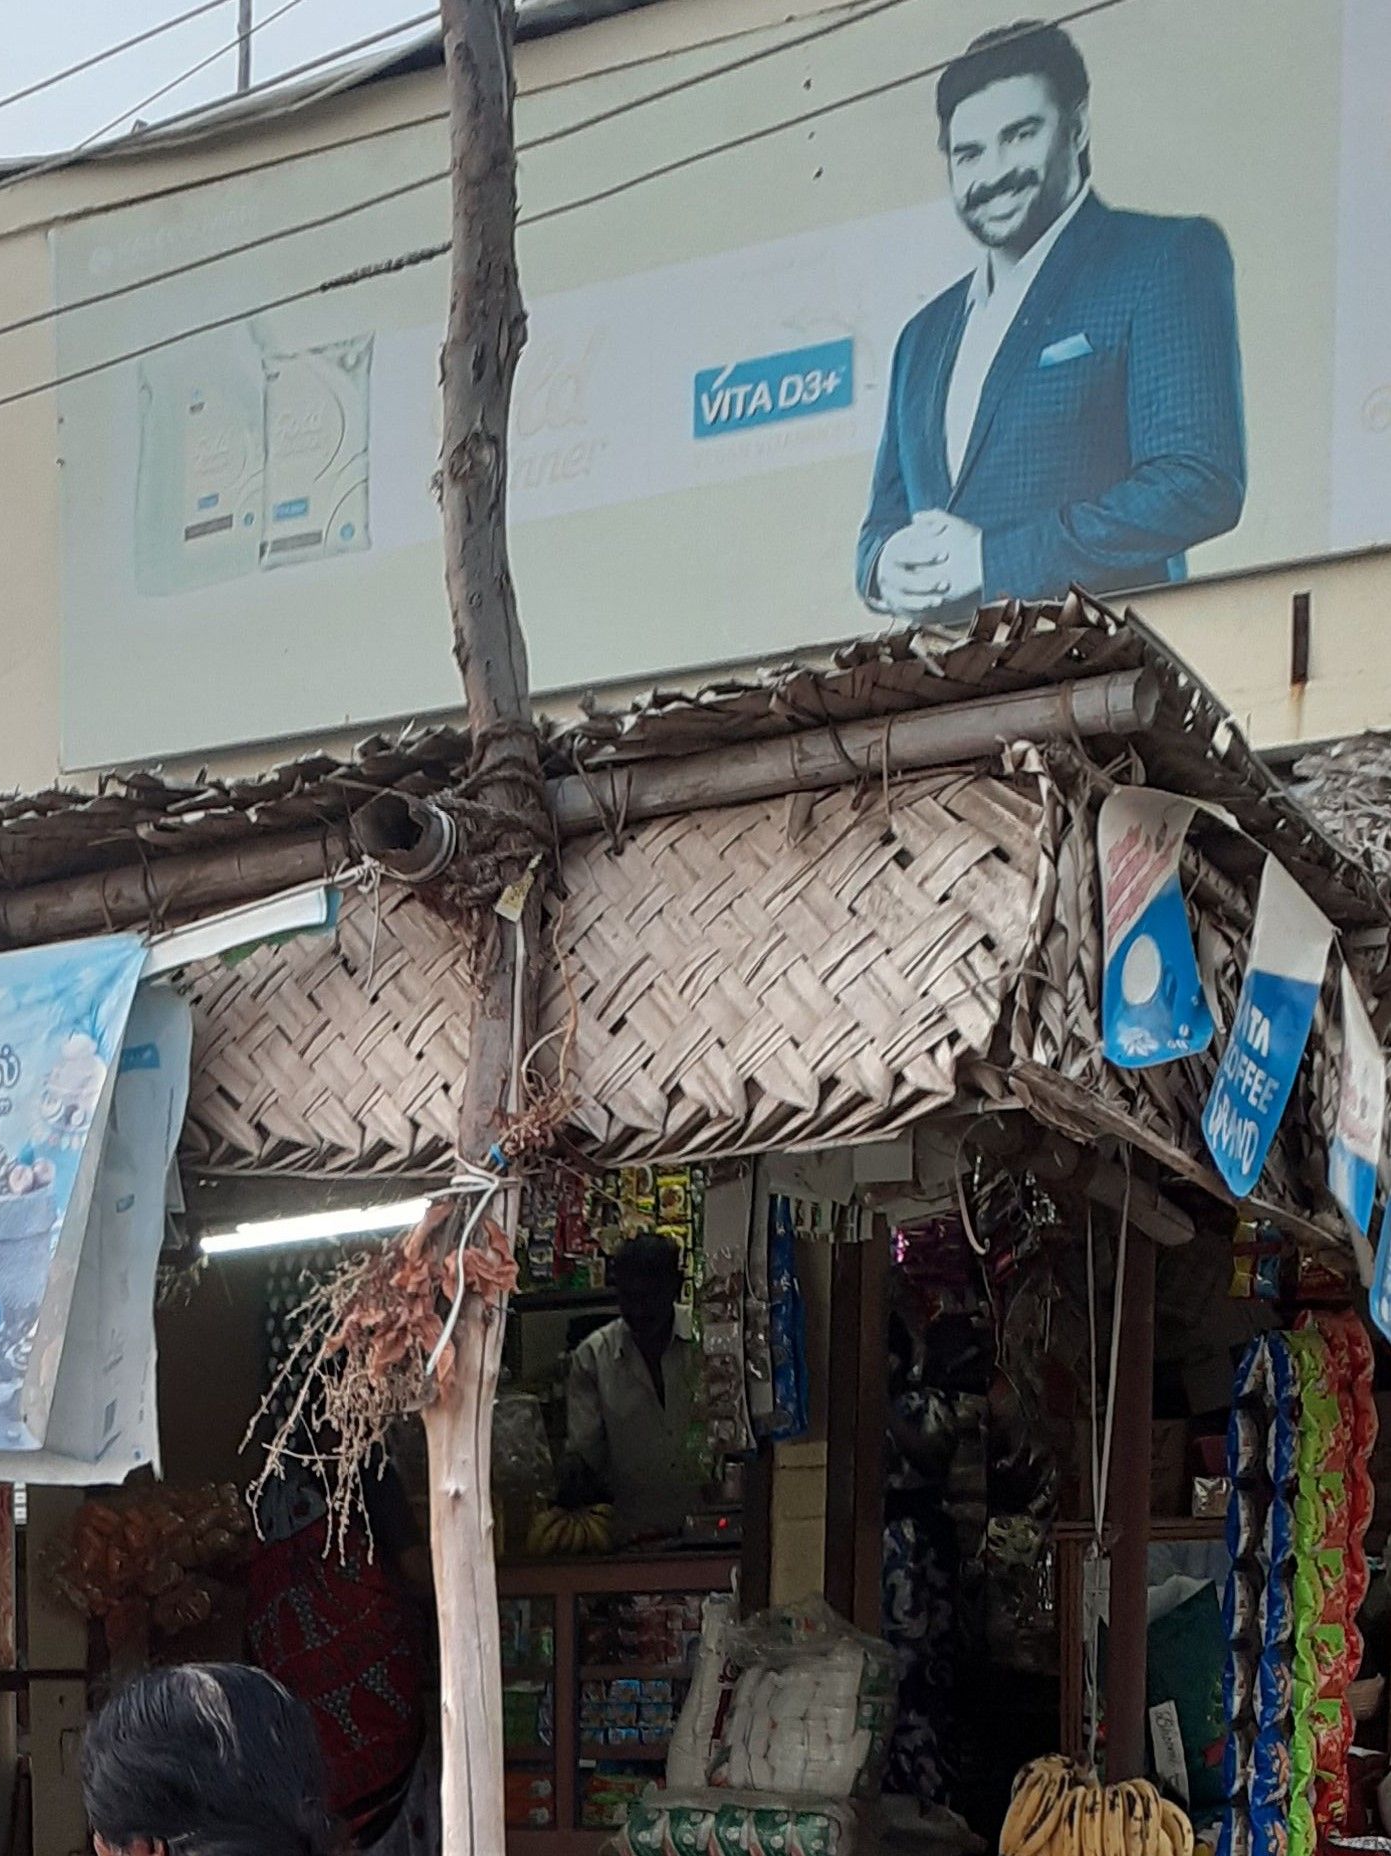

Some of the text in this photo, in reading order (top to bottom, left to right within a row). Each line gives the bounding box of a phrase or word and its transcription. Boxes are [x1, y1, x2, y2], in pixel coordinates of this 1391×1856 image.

[701, 367, 842, 425] VITA D3+
[1235, 1003, 1270, 1058] ATA
[1222, 1043, 1281, 1115] OFFEE
